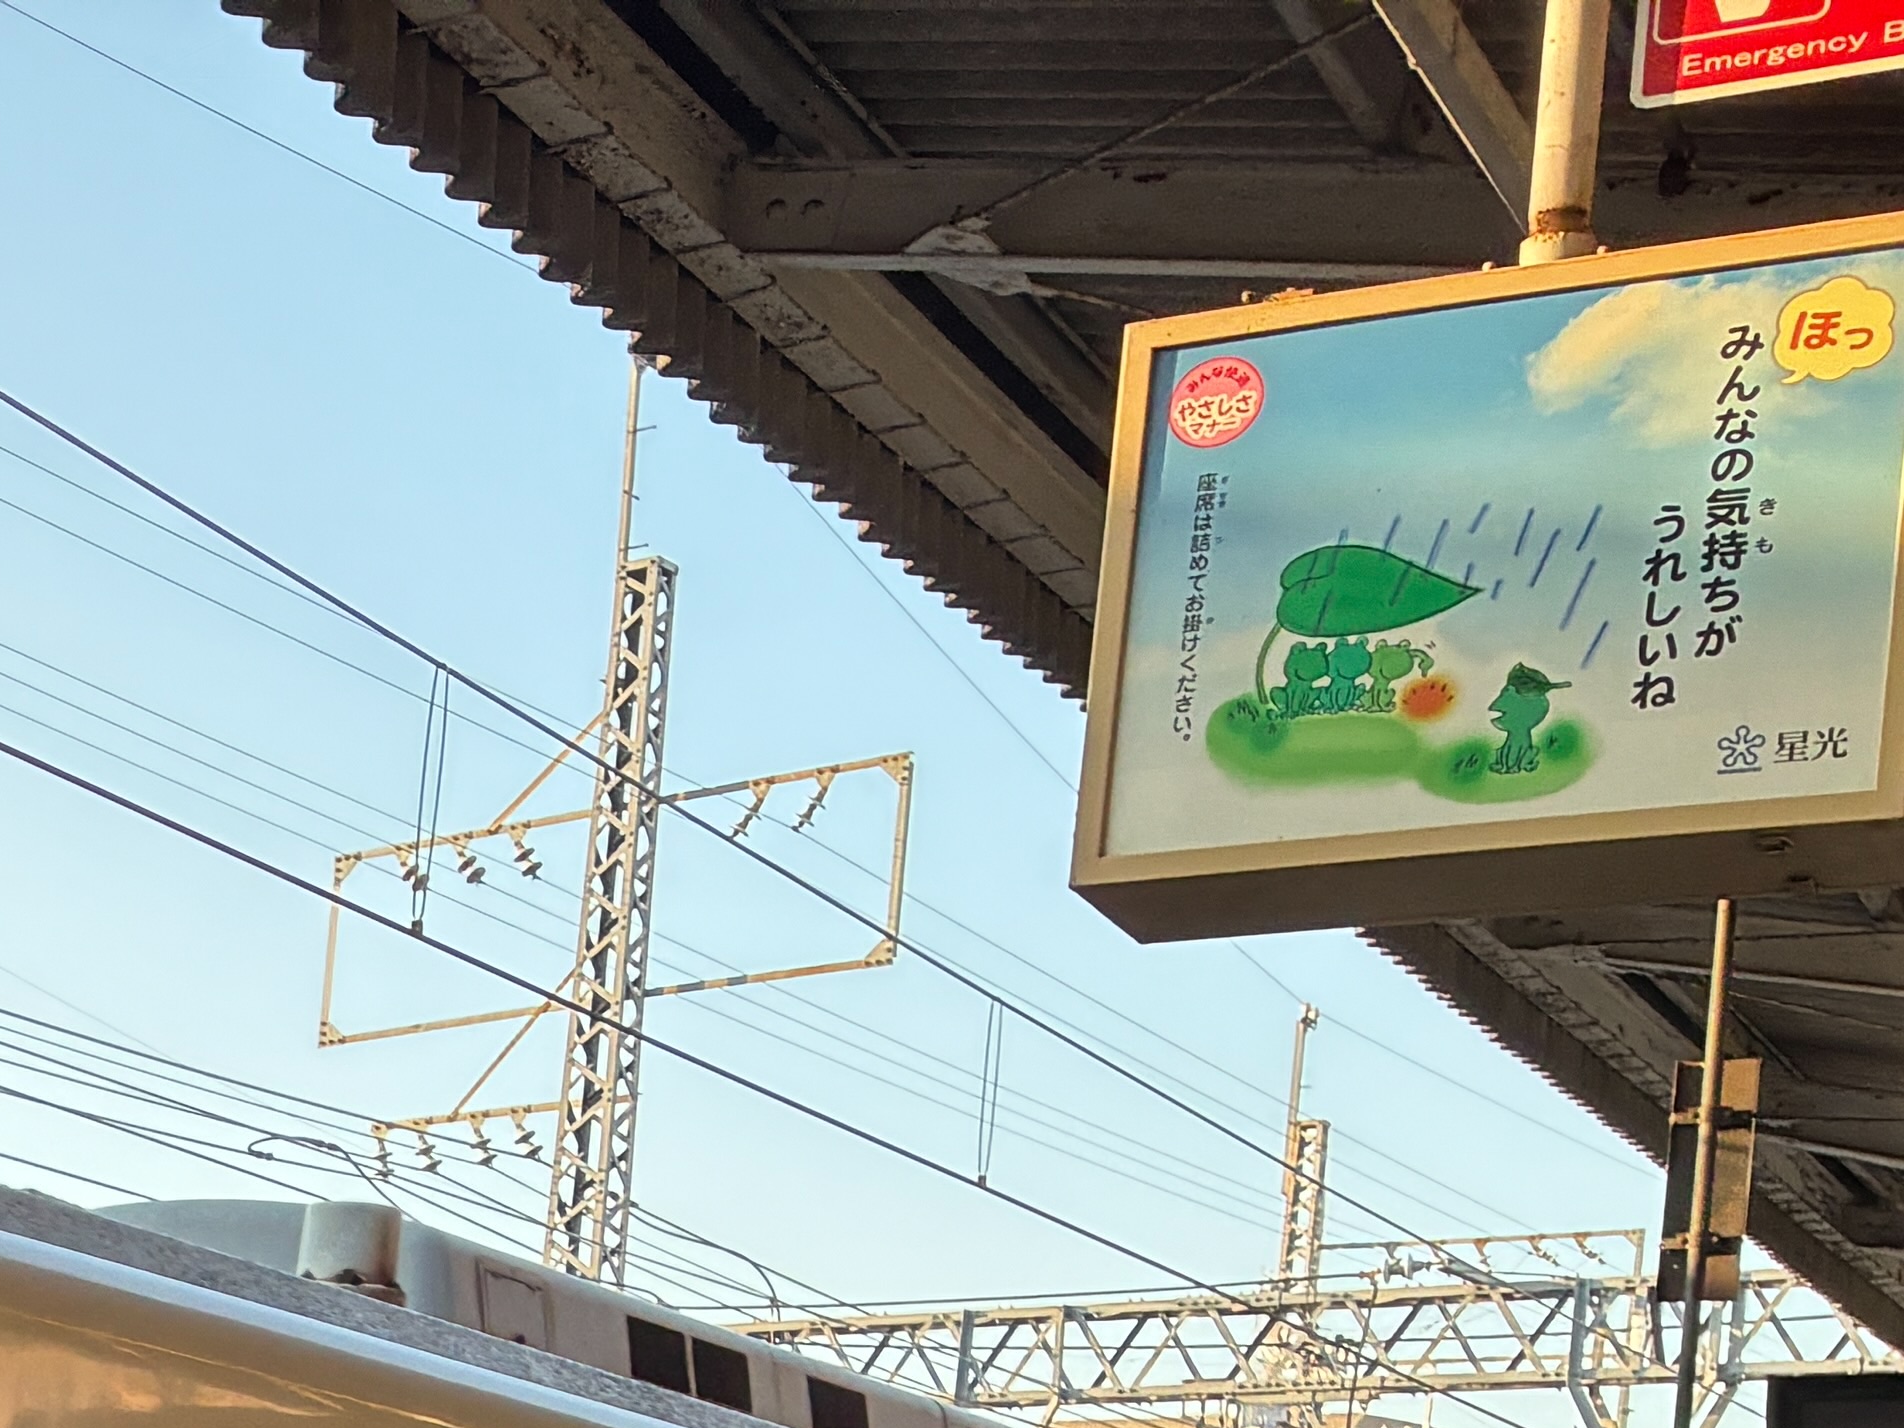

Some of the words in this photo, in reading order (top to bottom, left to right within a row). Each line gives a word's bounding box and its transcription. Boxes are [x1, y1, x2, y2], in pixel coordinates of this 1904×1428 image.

[1682, 31, 1869, 77] Emergency
[1789, 310, 1874, 350] ほっ
[1178, 394, 1253, 423] やさしさ
[1189, 419, 1237, 435] マナー
[1694, 325, 1765, 658] みんなの気持ちが
[1173, 472, 1220, 742] 座席は詰めてお掛けください。
[1630, 504, 1688, 709] うれしいね
[1773, 726, 1849, 764] 星光
